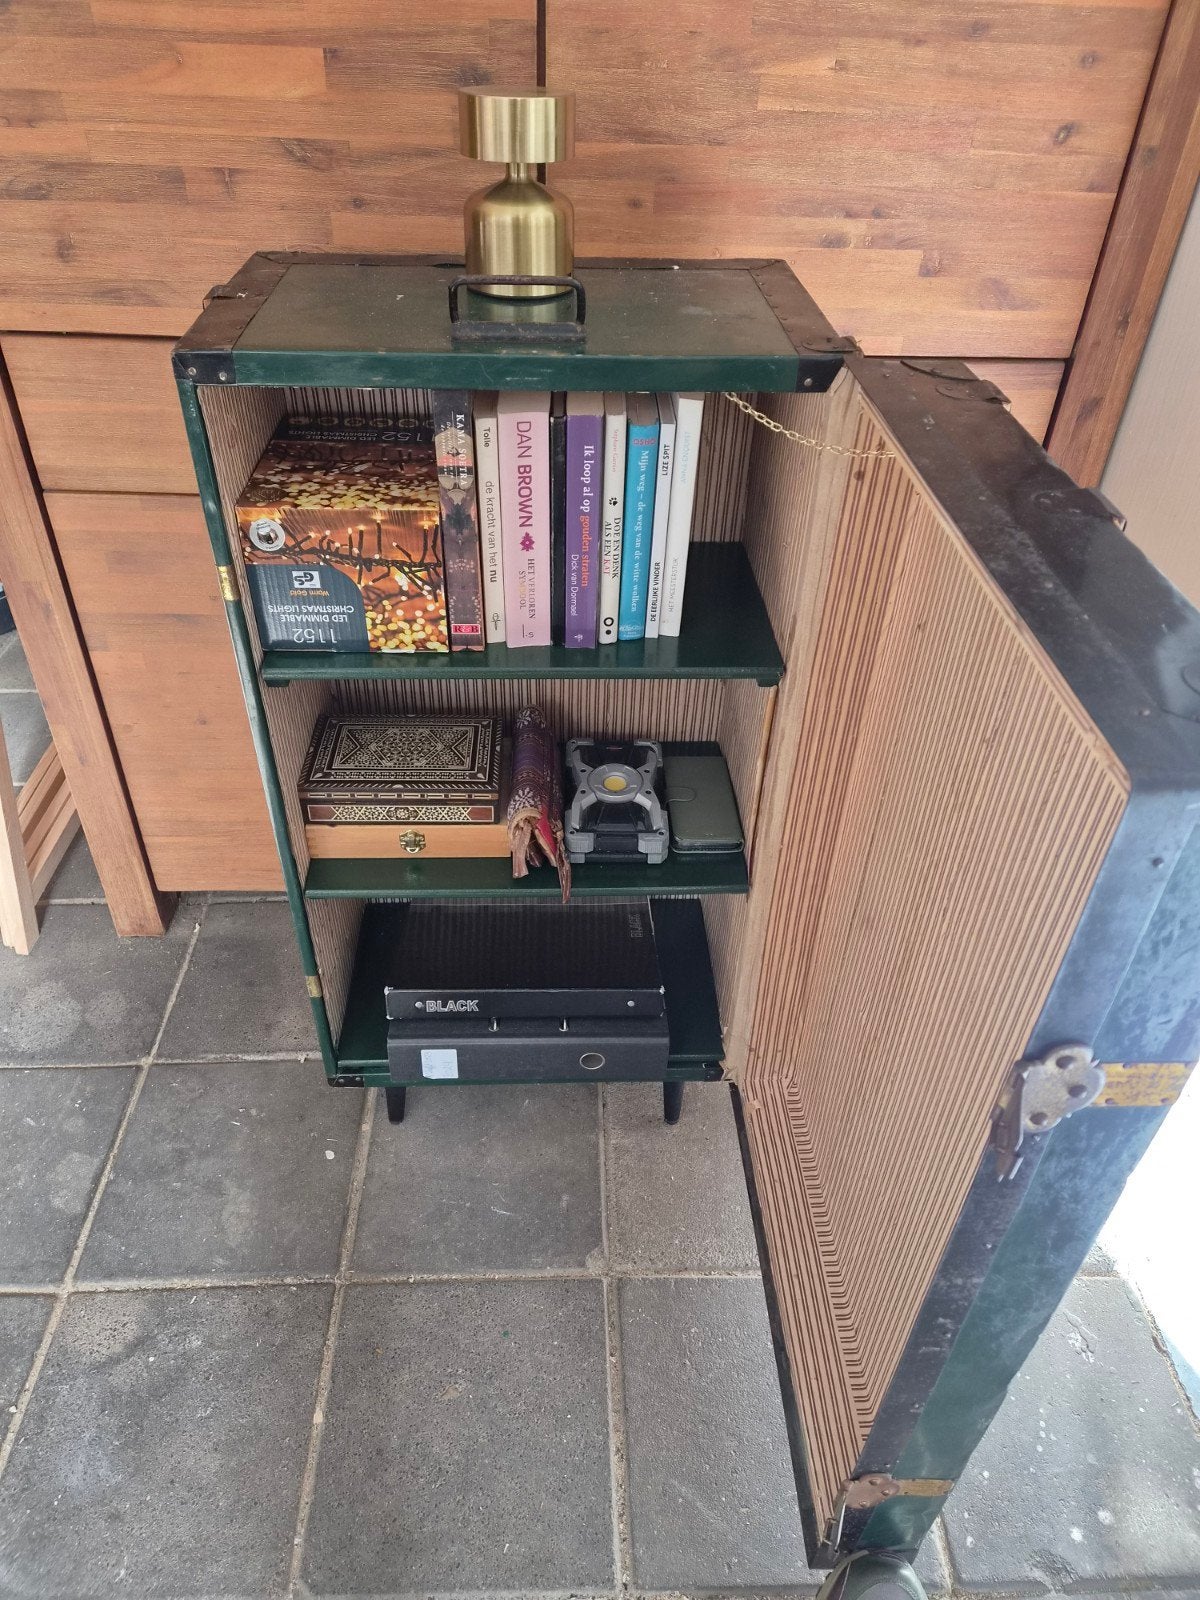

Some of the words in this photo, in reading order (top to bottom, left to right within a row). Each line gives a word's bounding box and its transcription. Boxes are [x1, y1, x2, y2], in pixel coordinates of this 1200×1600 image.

[456, 413, 466, 445] KAMA
[483, 426, 491, 448] Tolle
[516, 420, 533, 459] DAN
[583, 444, 595, 457] Ik
[663, 444, 671, 461] SPIT
[638, 450, 650, 472] Mijn
[662, 461, 670, 476] LIZE
[580, 459, 595, 484] loop
[485, 480, 493, 494] de
[582, 485, 594, 497] al
[636, 473, 646, 492] weg
[517, 464, 533, 528] BROWN
[486, 496, 498, 529] kracht
[579, 498, 591, 513] op
[637, 501, 647, 513] de
[604, 520, 612, 538] ALS
[613, 516, 621, 537] DOE
[633, 514, 644, 532] weg
[488, 532, 496, 550] van
[579, 515, 593, 553] gouden
[634, 533, 643, 548] van
[603, 539, 612, 557] EEN
[612, 537, 620, 551] EN
[489, 551, 498, 568] het
[571, 554, 580, 569] Dick
[634, 548, 642, 561] de
[527, 558, 535, 576] HET
[581, 552, 591, 587] straten
[603, 558, 611, 576] KAT
[611, 551, 620, 579] DENK
[631, 561, 642, 583] witte
[653, 561, 661, 587] VINDER
[293, 571, 315, 586] GS
[489, 569, 497, 583] nu
[288, 589, 308, 597] Gold
[308, 589, 330, 597] Warm
[528, 577, 536, 619] VERLOREN
[570, 586, 579, 617] Dormael
[630, 584, 641, 612] wolken
[651, 587, 659, 613] EERLIJKE
[268, 604, 300, 613] LIGHTS
[301, 605, 355, 613] CHRISTMAS
[650, 613, 657, 622] DE
[280, 614, 330, 622] DIMMABLE
[332, 614, 348, 623] LED
[293, 628, 338, 644] 1152
[425, 999, 479, 1013] BLACK
